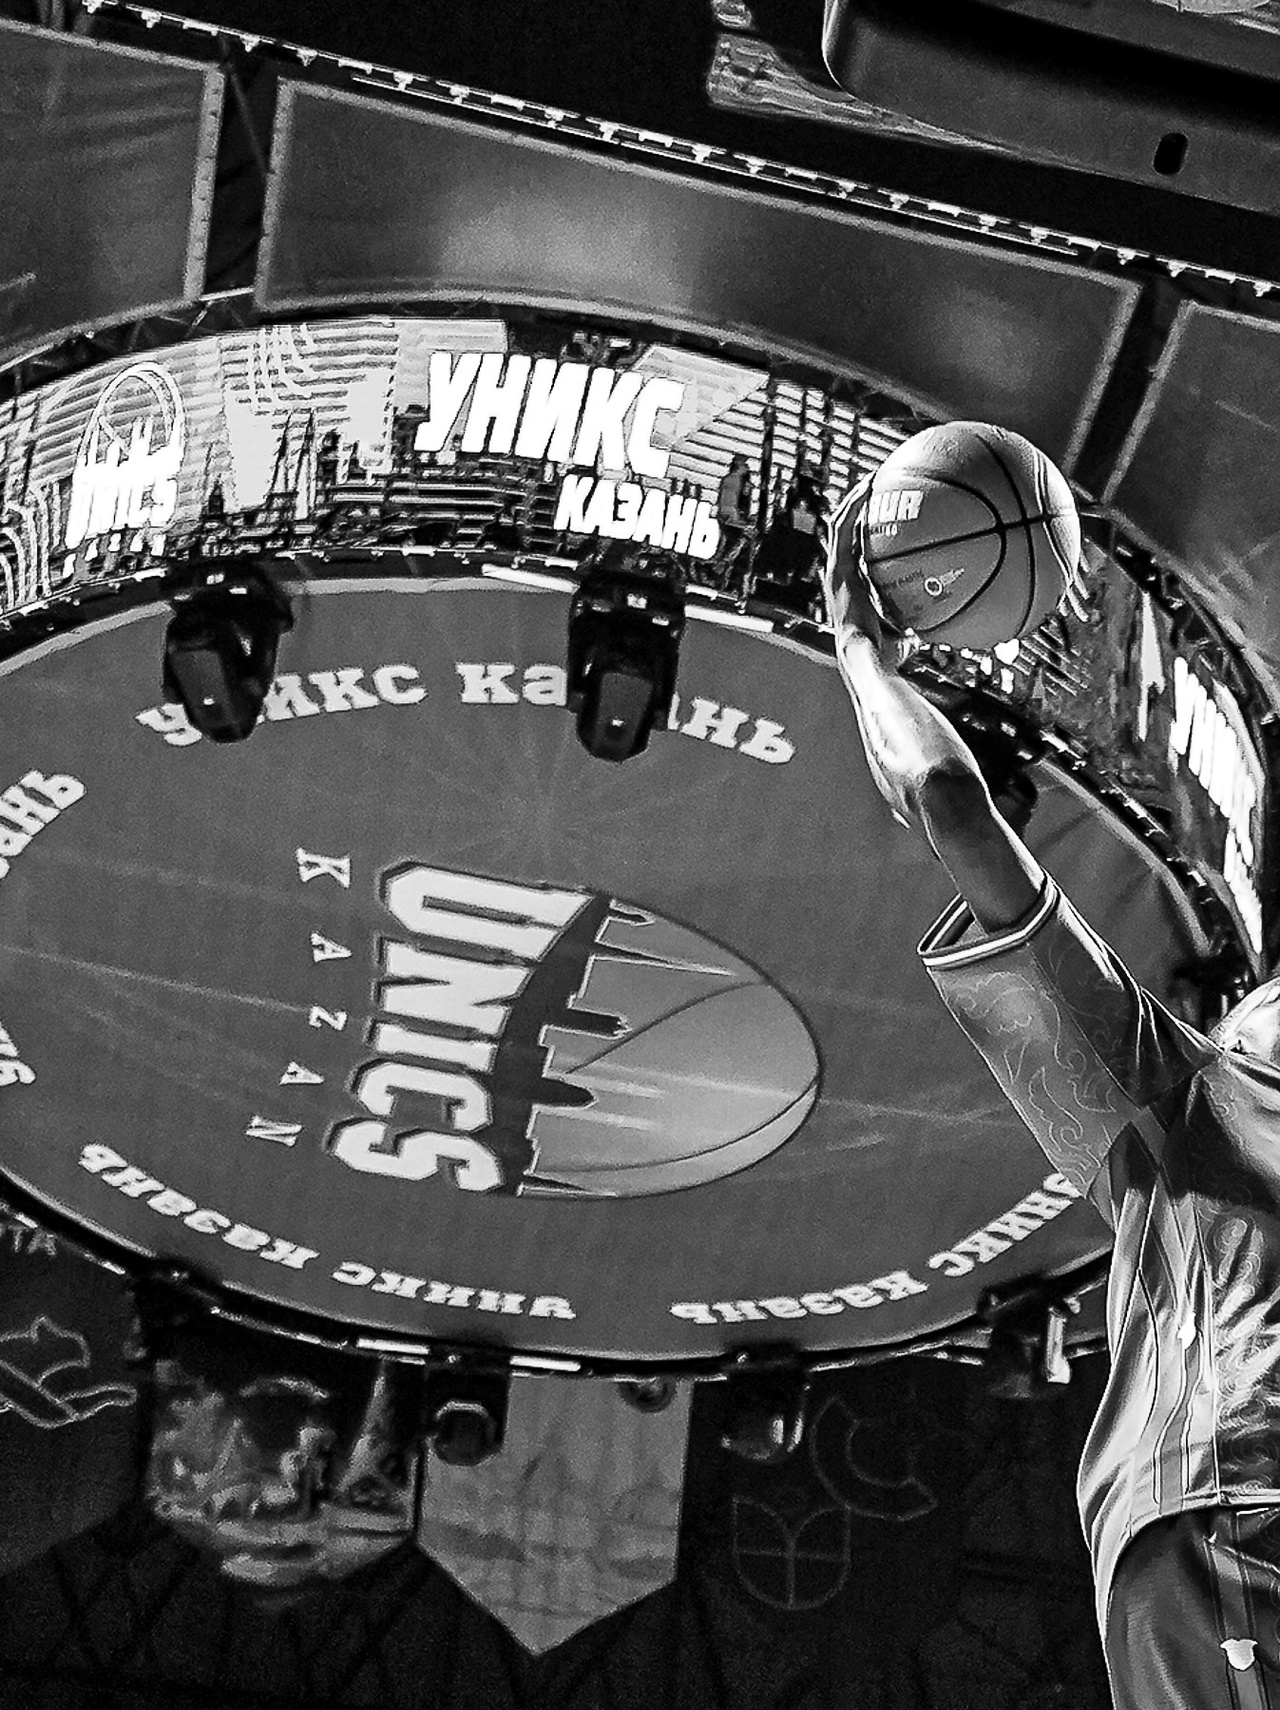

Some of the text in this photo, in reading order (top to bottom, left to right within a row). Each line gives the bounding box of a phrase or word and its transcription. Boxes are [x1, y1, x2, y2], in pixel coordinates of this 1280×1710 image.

[414, 350, 686, 477] УНИКС
[553, 474, 722, 560] КАЗАНЬ
[135, 660, 797, 765] уикс кань
[330, 864, 592, 1193] UNICS
